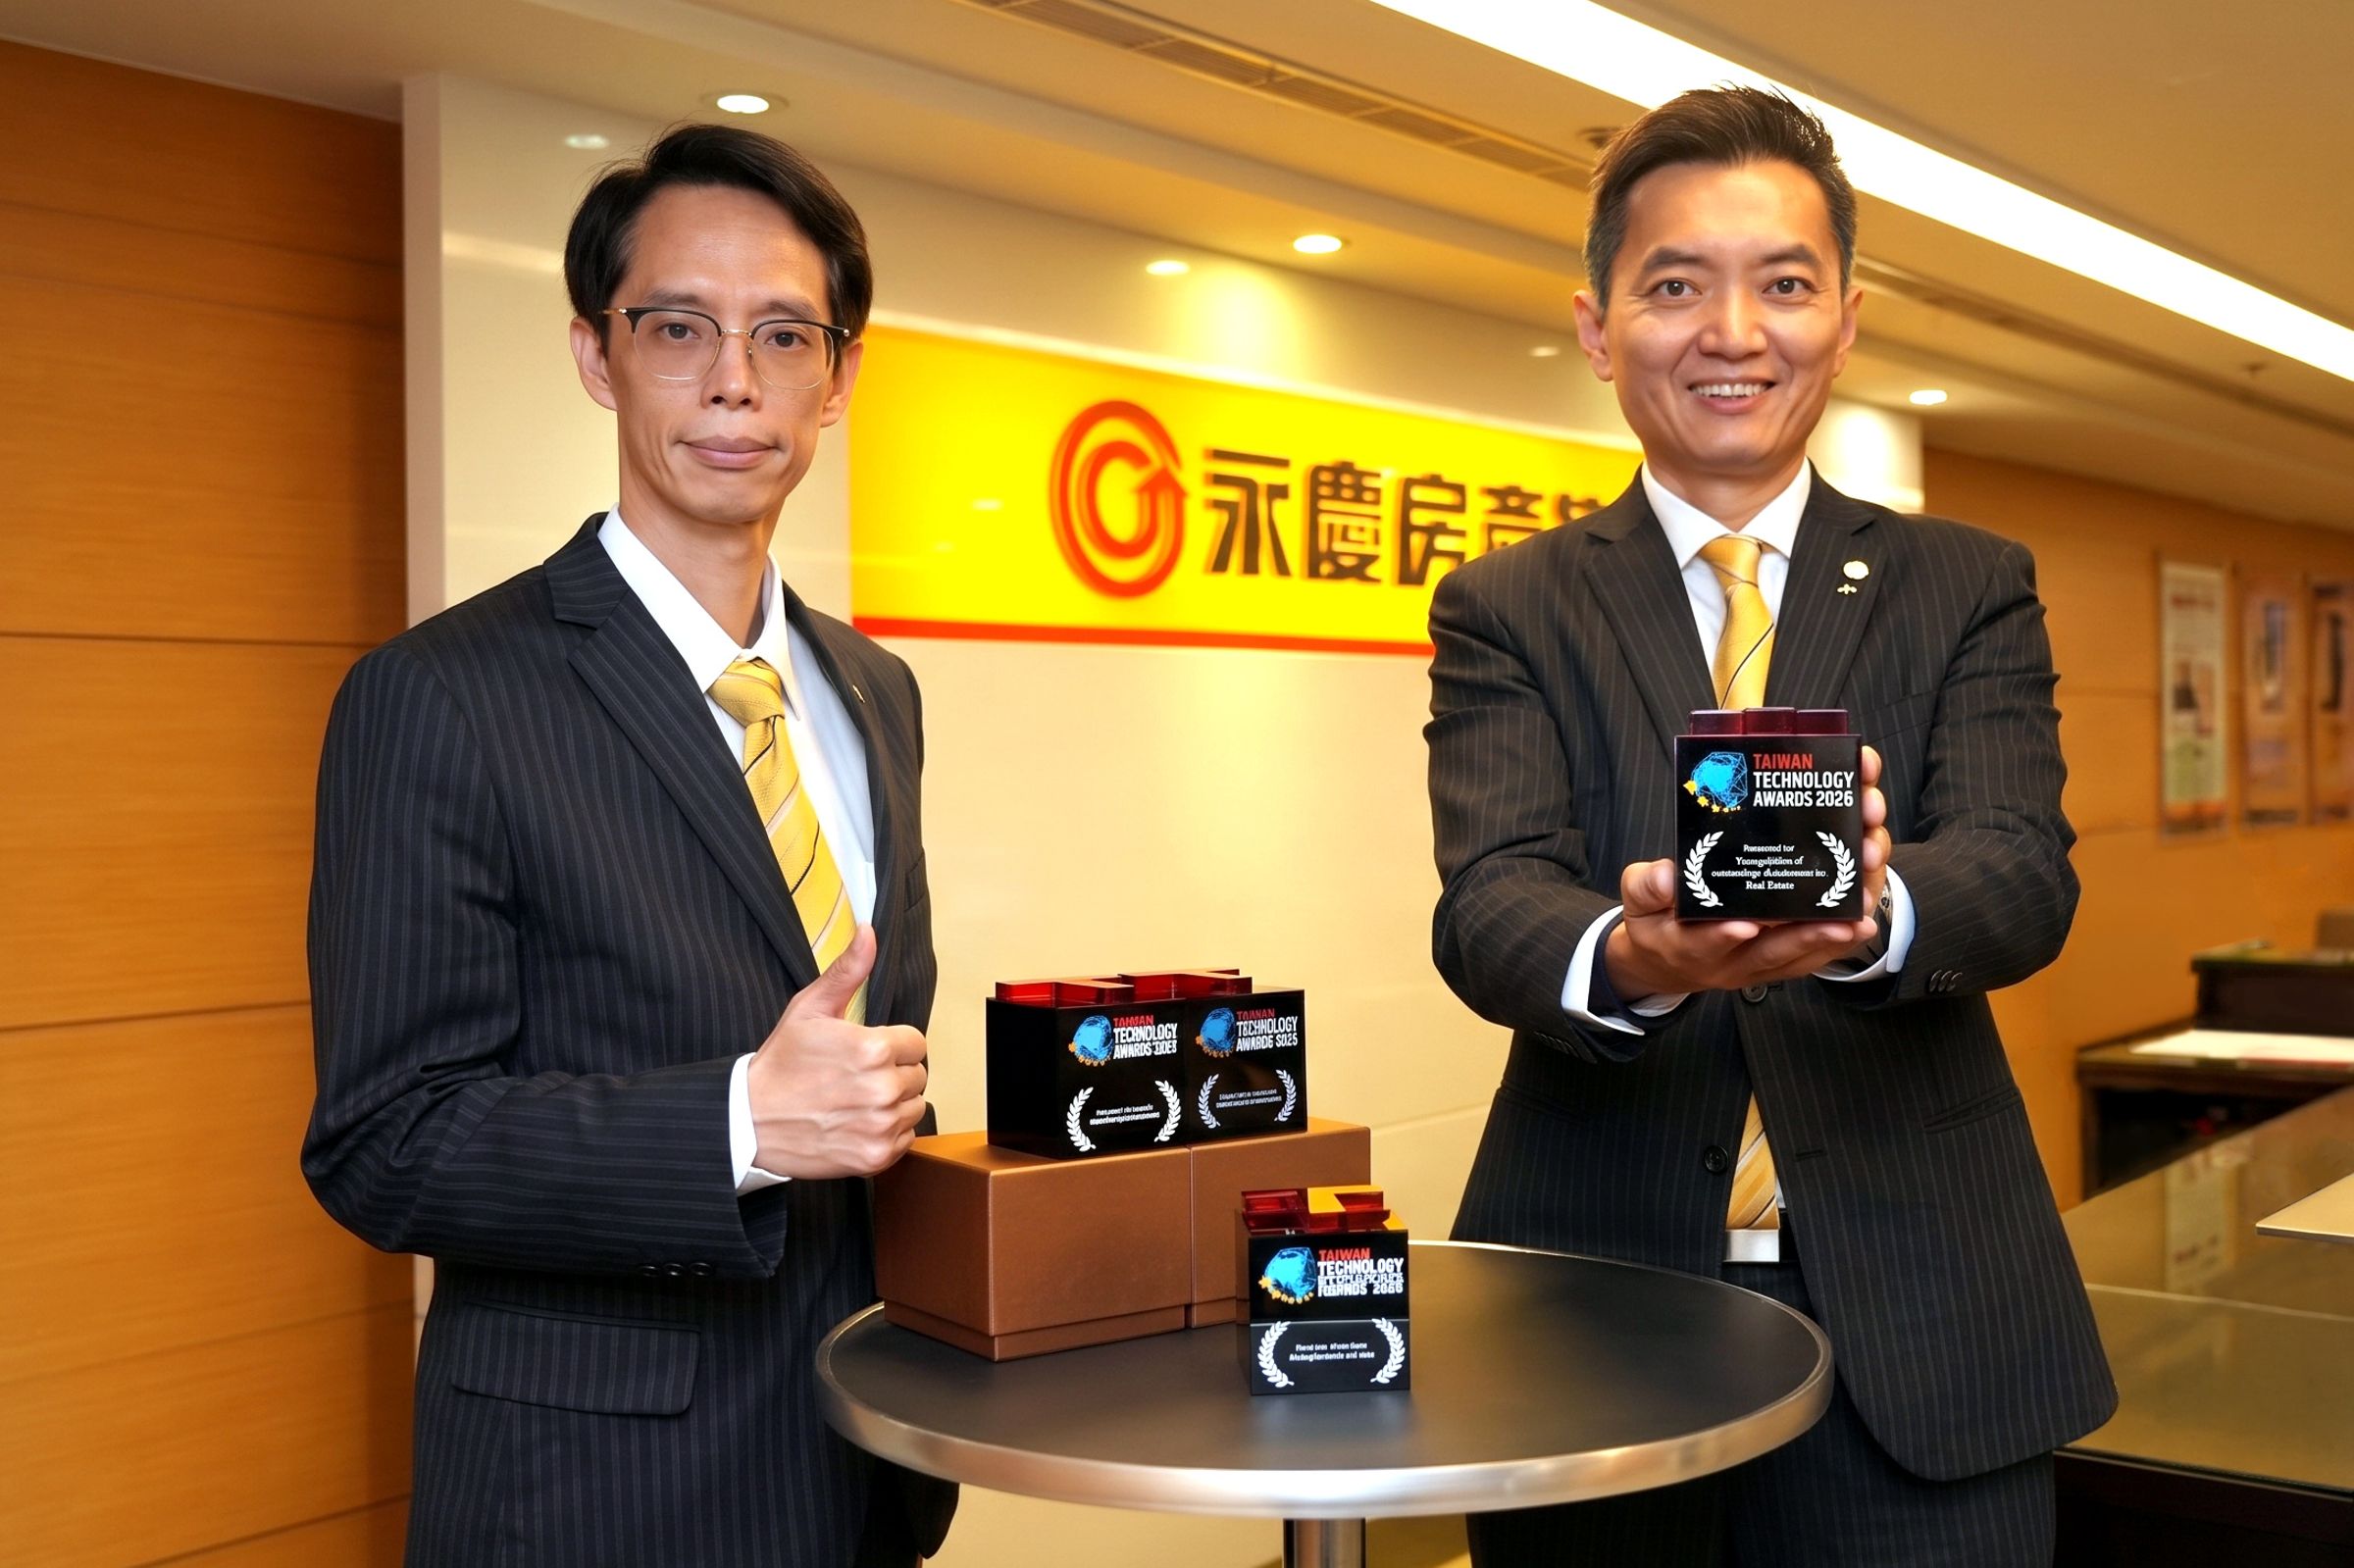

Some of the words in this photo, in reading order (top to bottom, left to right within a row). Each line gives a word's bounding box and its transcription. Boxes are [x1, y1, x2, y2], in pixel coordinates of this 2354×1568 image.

[1204, 447, 1609, 586] 永慶房產
[1753, 753, 1813, 769] TAIWAN
[1753, 771, 1855, 788] TECHNOLOGY
[1753, 790, 1814, 807] AWARDS
[1816, 790, 1854, 807] 2026
[1794, 856, 1805, 865] of
[1746, 881, 1766, 889] Real
[1766, 881, 1795, 889] Estate
[1318, 1247, 1371, 1261] TAIWAN
[1317, 1257, 1405, 1276] TECHNOLOGY
